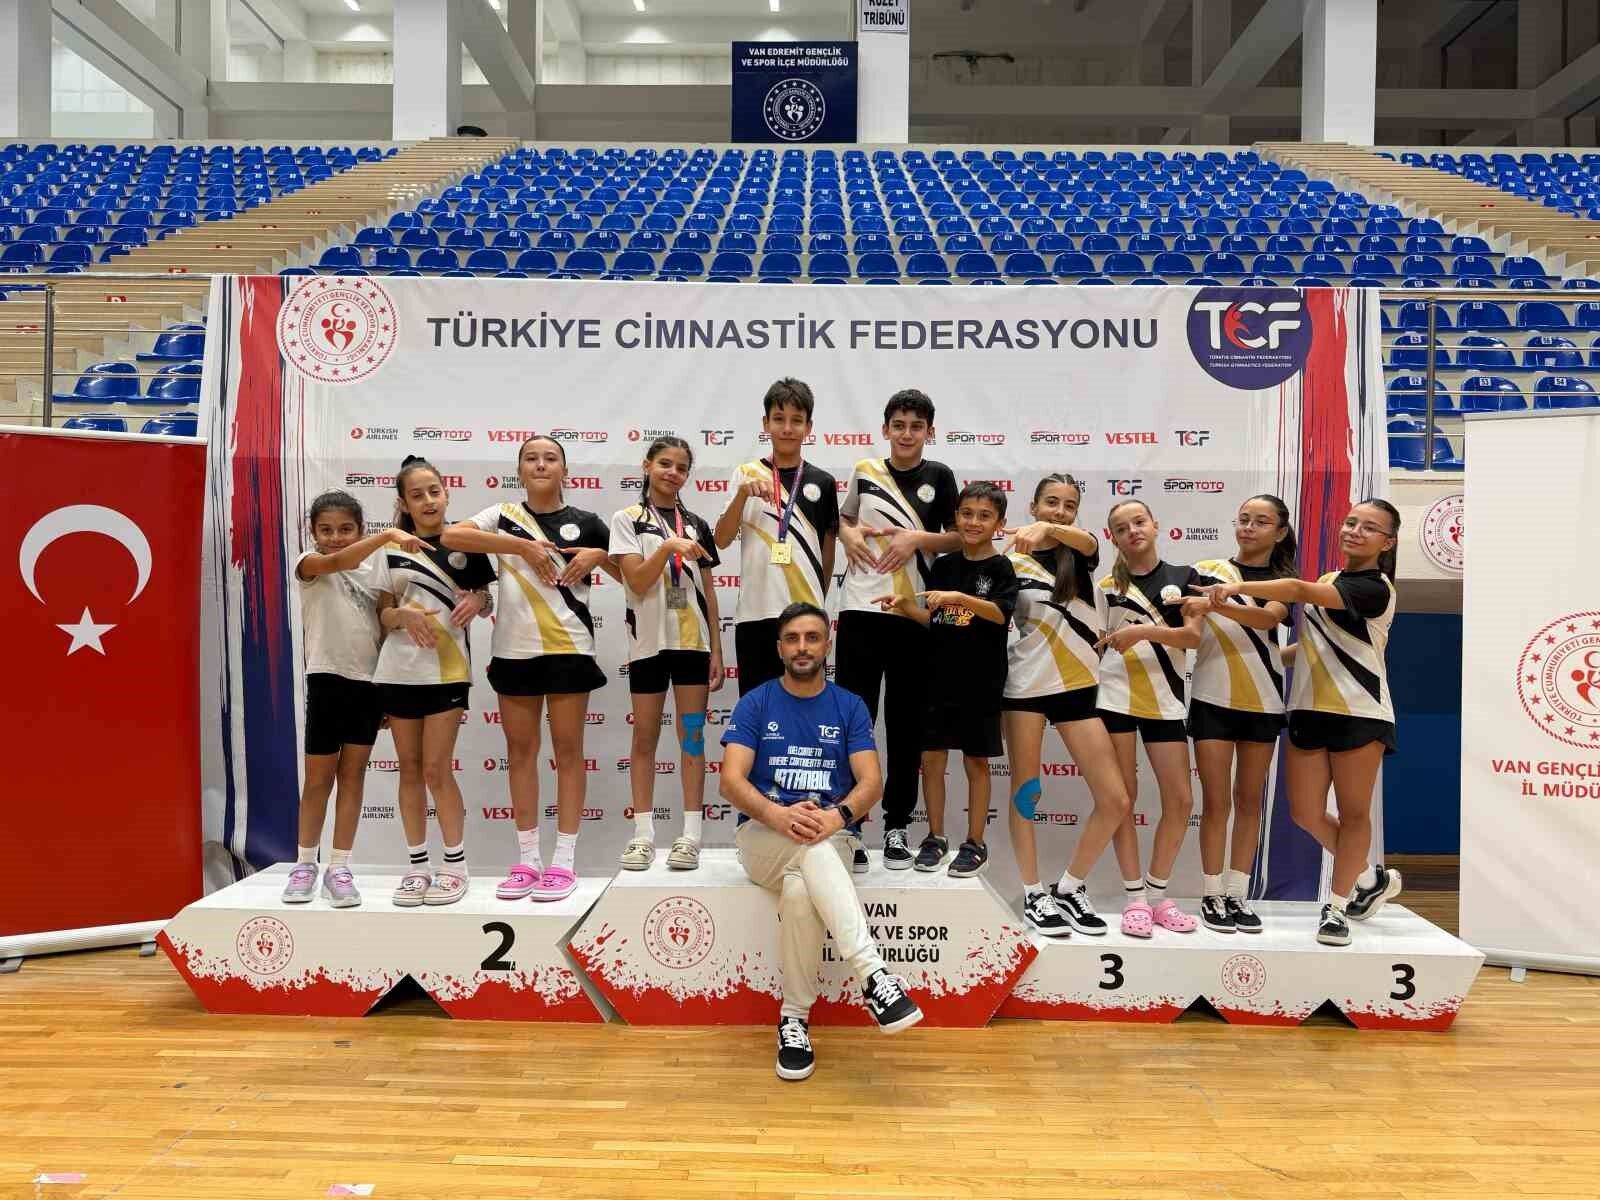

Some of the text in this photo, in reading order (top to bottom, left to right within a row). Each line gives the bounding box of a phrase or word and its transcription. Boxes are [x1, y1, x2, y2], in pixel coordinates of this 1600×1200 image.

[864, 9, 904, 25] TRİBÜNÜ
[767, 46, 803, 55] EDREMİT
[805, 46, 841, 57] GENÇLİK
[777, 57, 795, 67] İLÇE
[798, 57, 849, 66] MÜDÜRLÜĞÜ
[426, 310, 1158, 350] TÜRKİYE CİMNASTİK FEDERASYONU
[1194, 301, 1301, 350] TCF
[701, 430, 735, 446] TCF
[824, 433, 874, 445] VESTEL
[946, 434, 1005, 443] SPORTOTO
[1031, 434, 1090, 443] SPORTOTO
[1105, 432, 1159, 444] VESTEL
[1175, 430, 1210, 446] TCF
[696, 480, 729, 491] VEST
[1108, 480, 1143, 496] TCF
[1164, 481, 1225, 490] SPORTOTO
[818, 724, 840, 738] TCF
[1042, 763, 1081, 776] VEST
[1491, 759, 1531, 774] VAN
[1521, 779, 1537, 796] İL
[864, 903, 897, 918] VAN
[885, 926, 903, 940] VE
[908, 926, 948, 940] SPOR
[481, 922, 516, 970] 2
[822, 943, 835, 962] İL
[1098, 953, 1125, 990] 3
[1389, 963, 1416, 1000] 3
